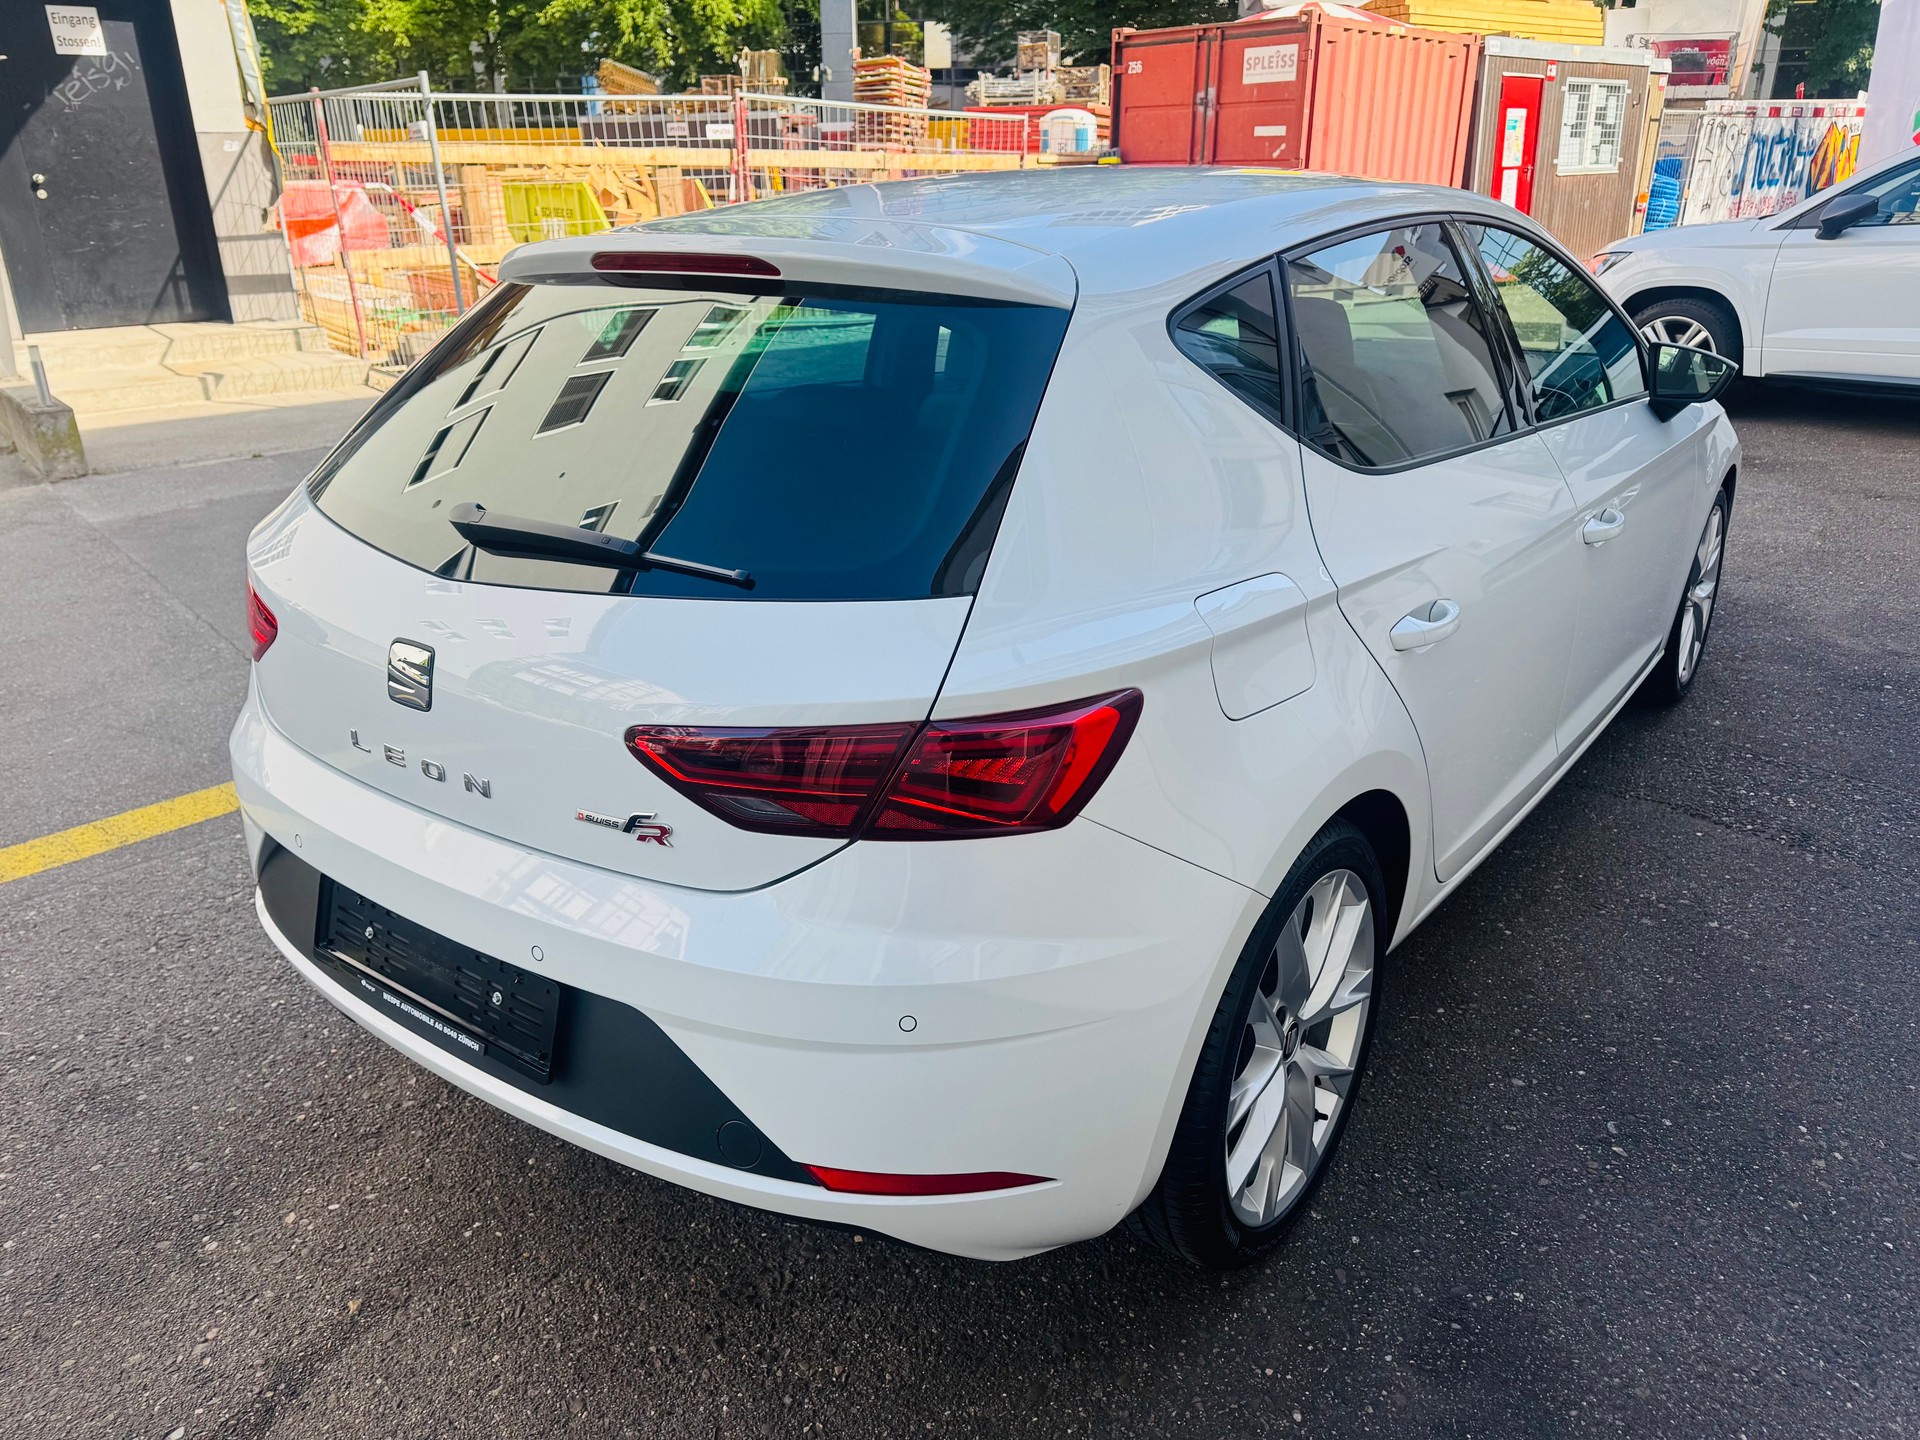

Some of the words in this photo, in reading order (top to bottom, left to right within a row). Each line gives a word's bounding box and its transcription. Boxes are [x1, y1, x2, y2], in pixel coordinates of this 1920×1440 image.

[50, 12, 96, 28] Eingang
[56, 36, 101, 47] Stossen!
[1128, 61, 1143, 74] 256
[350, 728, 491, 799] LEON
[585, 814, 619, 829] SWISS
[622, 812, 674, 848] FR
[383, 992, 400, 1007] WESPE
[400, 1003, 435, 1026] AUTOMOBILE
[434, 1022, 443, 1031] AG
[443, 1027, 458, 1039] 8048
[458, 1034, 480, 1051] ZÜRICH
